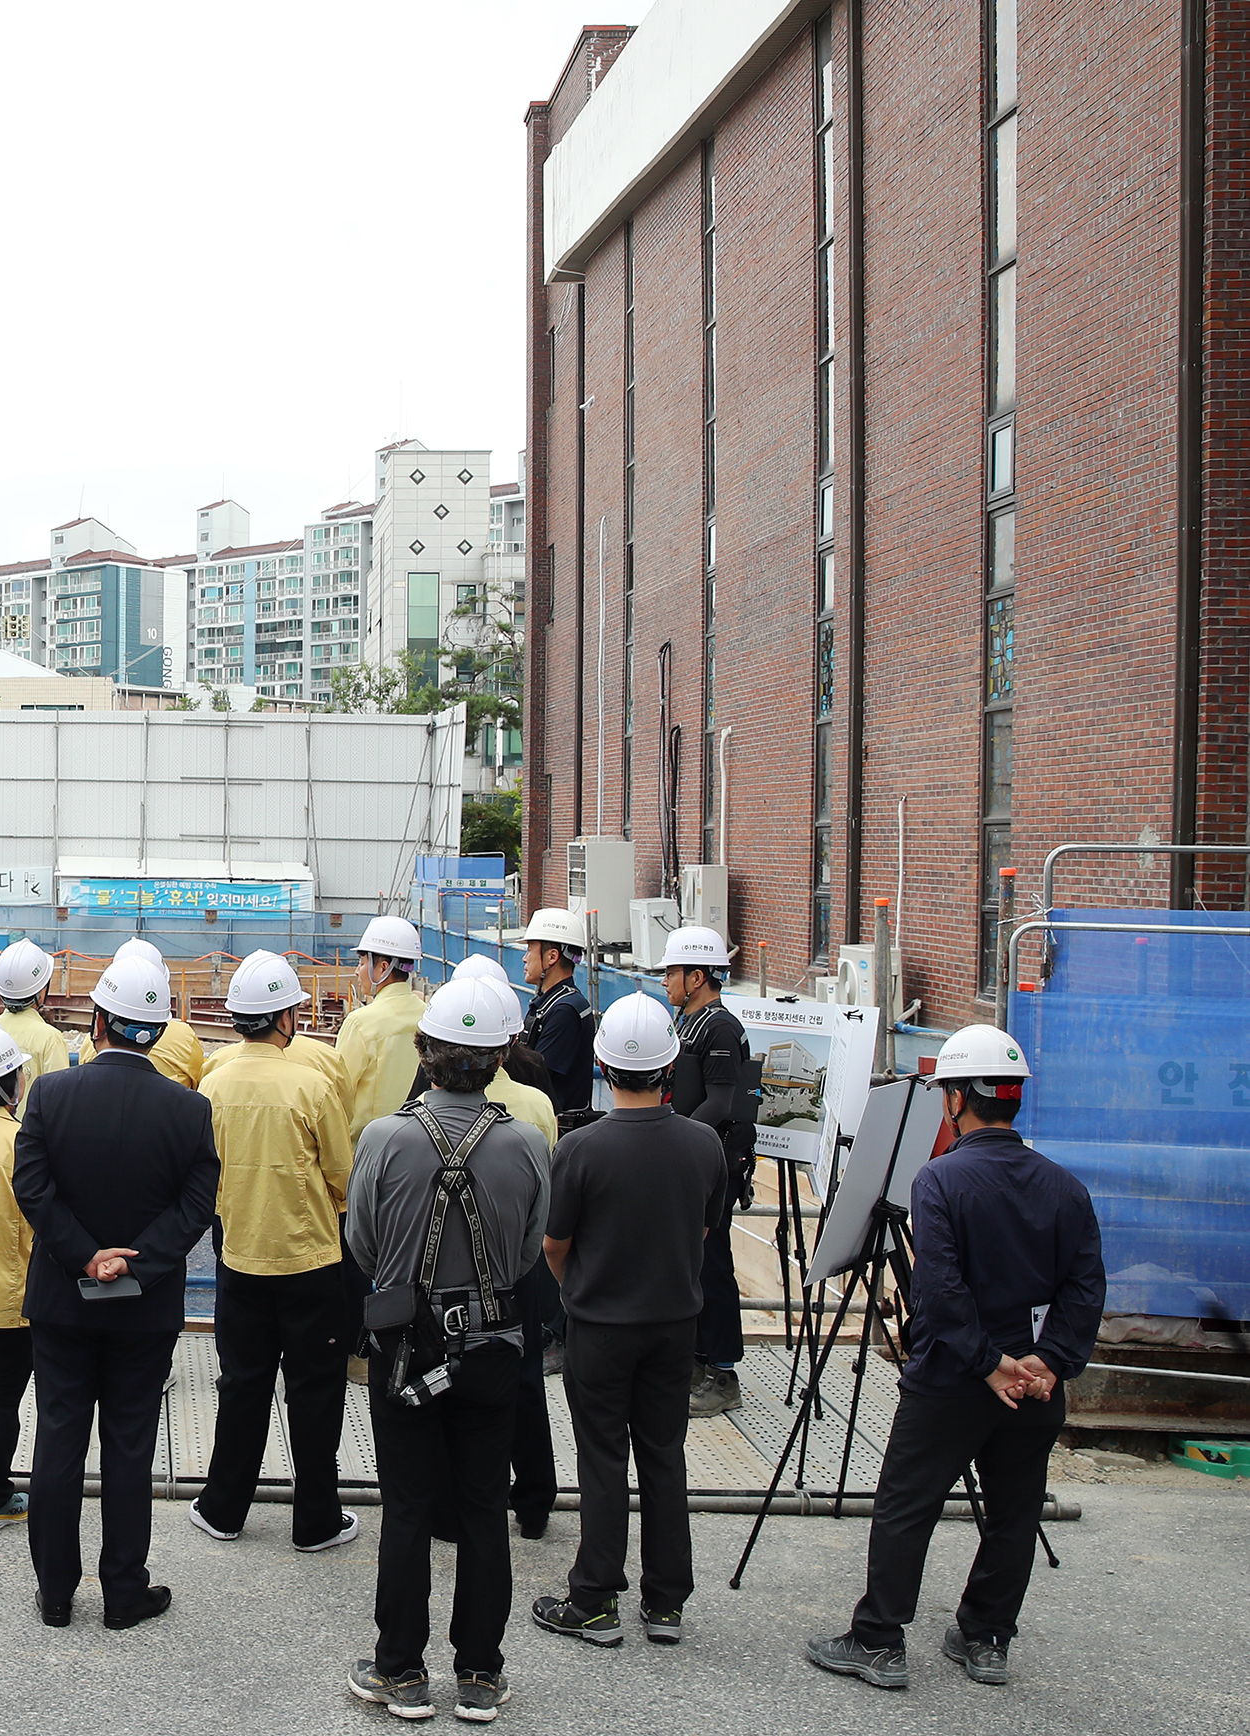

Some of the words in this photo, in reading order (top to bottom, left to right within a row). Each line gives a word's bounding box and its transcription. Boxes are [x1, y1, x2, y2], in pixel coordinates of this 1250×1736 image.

[147, 628, 157, 639] 10
[163, 647, 173, 689] GONG
[206, 893, 278, 907] 잊지마세요!
[432, 1216, 441, 1232] K2
[470, 1214, 480, 1231] K2
